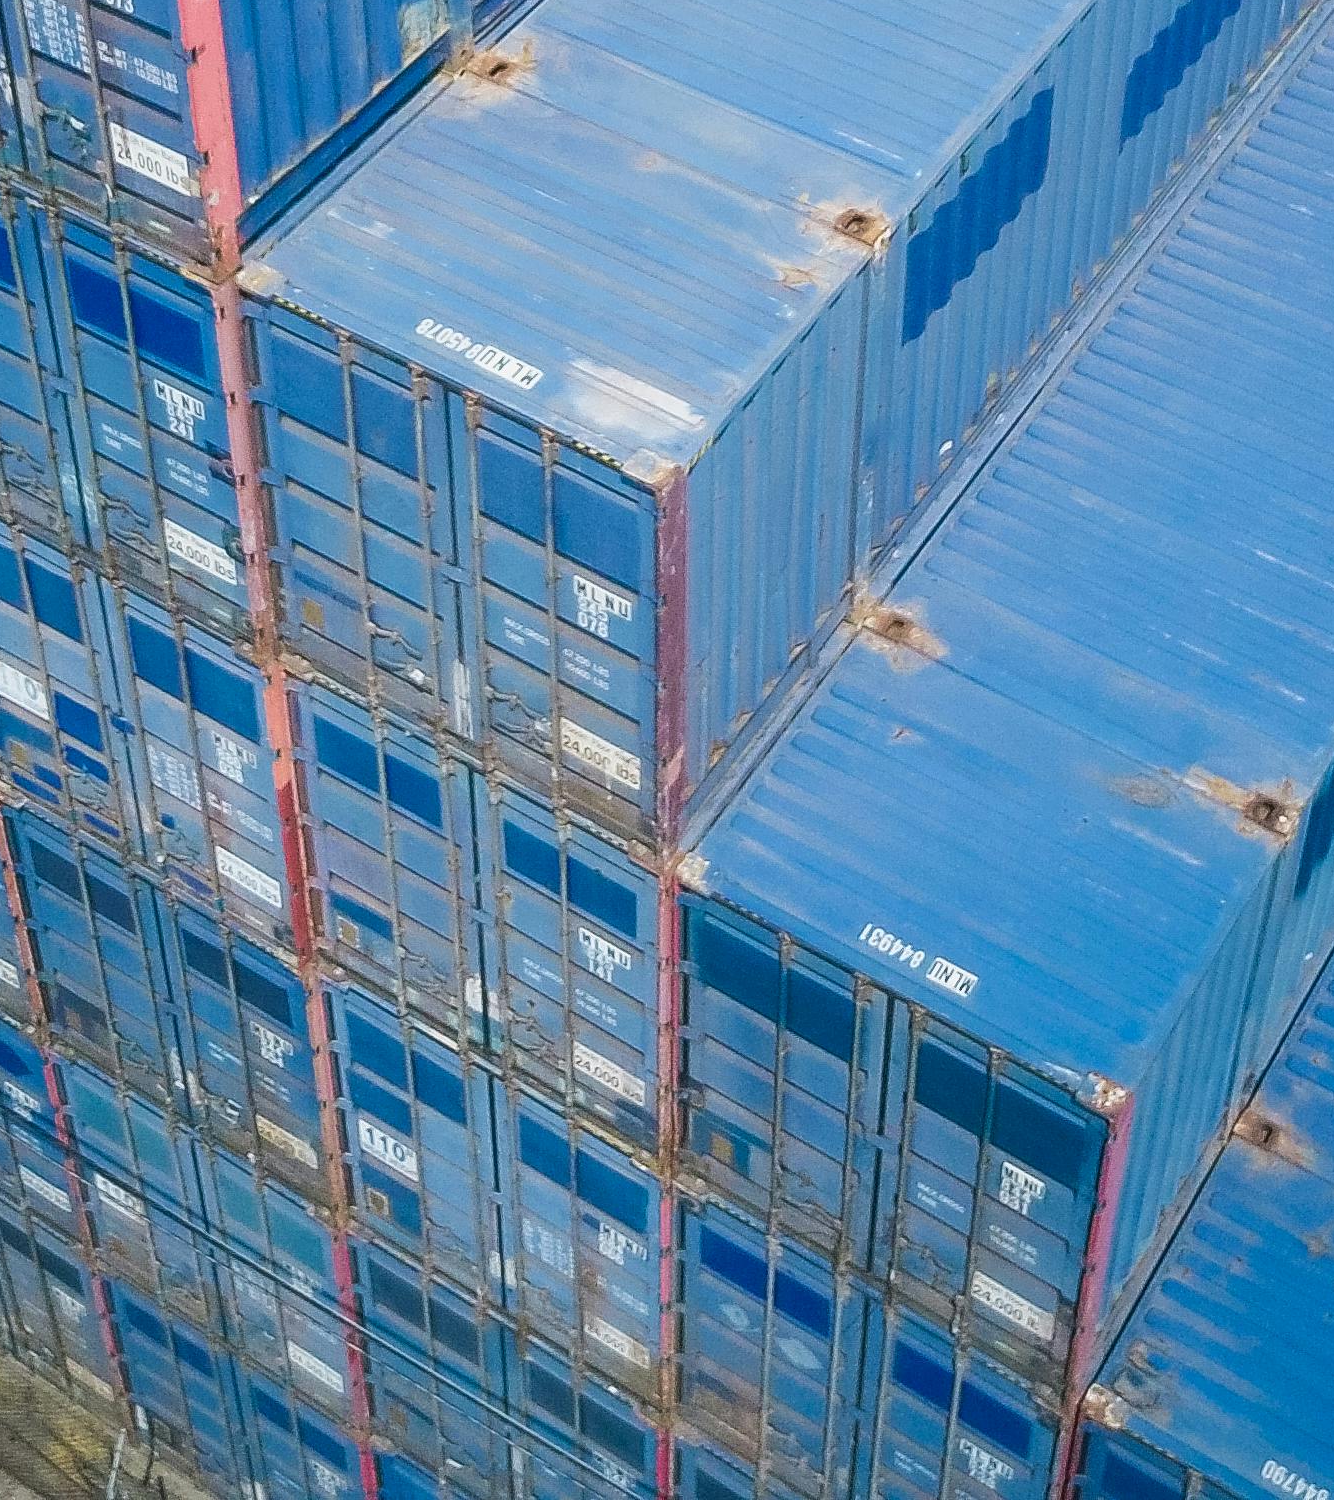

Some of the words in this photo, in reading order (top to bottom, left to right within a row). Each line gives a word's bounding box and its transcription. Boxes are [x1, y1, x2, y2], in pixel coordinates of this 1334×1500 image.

[116, 143, 162, 177] 24,000
[166, 167, 190, 191] lbs
[415, 316, 481, 360] 845078
[475, 344, 544, 389] MLNU
[154, 379, 205, 420] MLNU
[168, 536, 210, 568] 24,000
[215, 560, 236, 581] lbs
[574, 575, 632, 621] MLNU
[578, 611, 608, 638] 078
[563, 734, 611, 768] 24,000
[857, 922, 923, 968] 844931
[926, 956, 979, 997] MLNU
[576, 1054, 620, 1088] 24,000
[366, 1127, 405, 1162] 110
[973, 1284, 1023, 1321] 24,000
